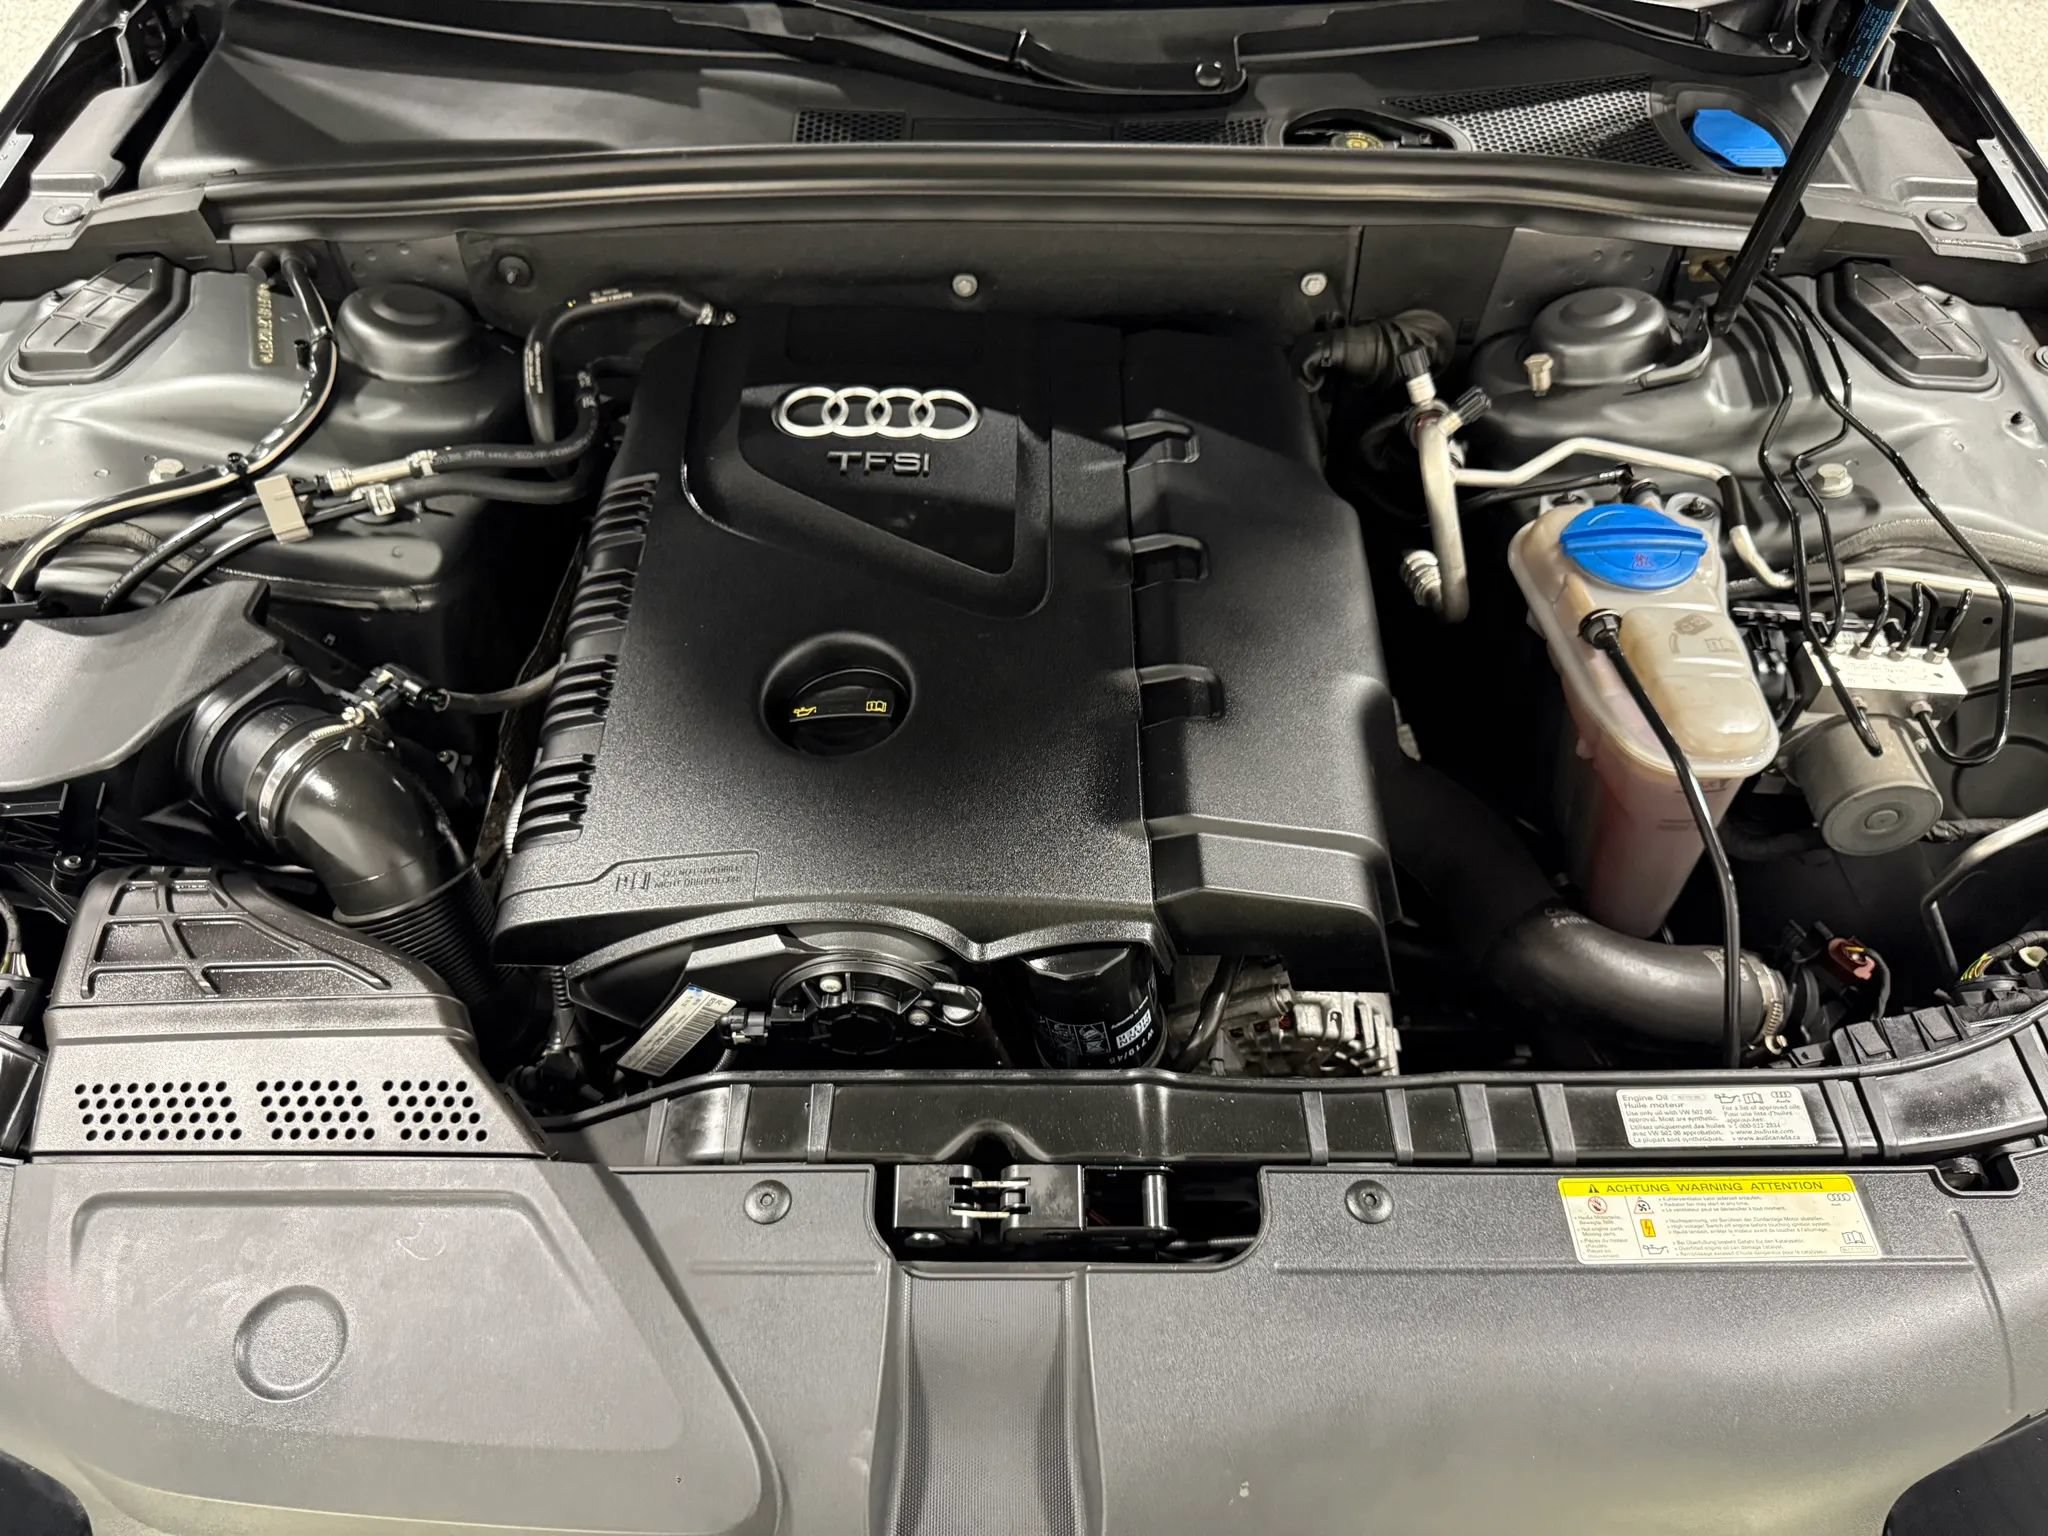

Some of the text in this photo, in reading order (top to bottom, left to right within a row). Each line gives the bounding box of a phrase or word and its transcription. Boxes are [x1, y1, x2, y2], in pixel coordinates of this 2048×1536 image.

[827, 451, 930, 474] TFSI
[1622, 1094, 1653, 1102] Engine
[1656, 1094, 1669, 1102] Oil
[1607, 1181, 1823, 1192] ACHTUNG WARNING ATTENTION
